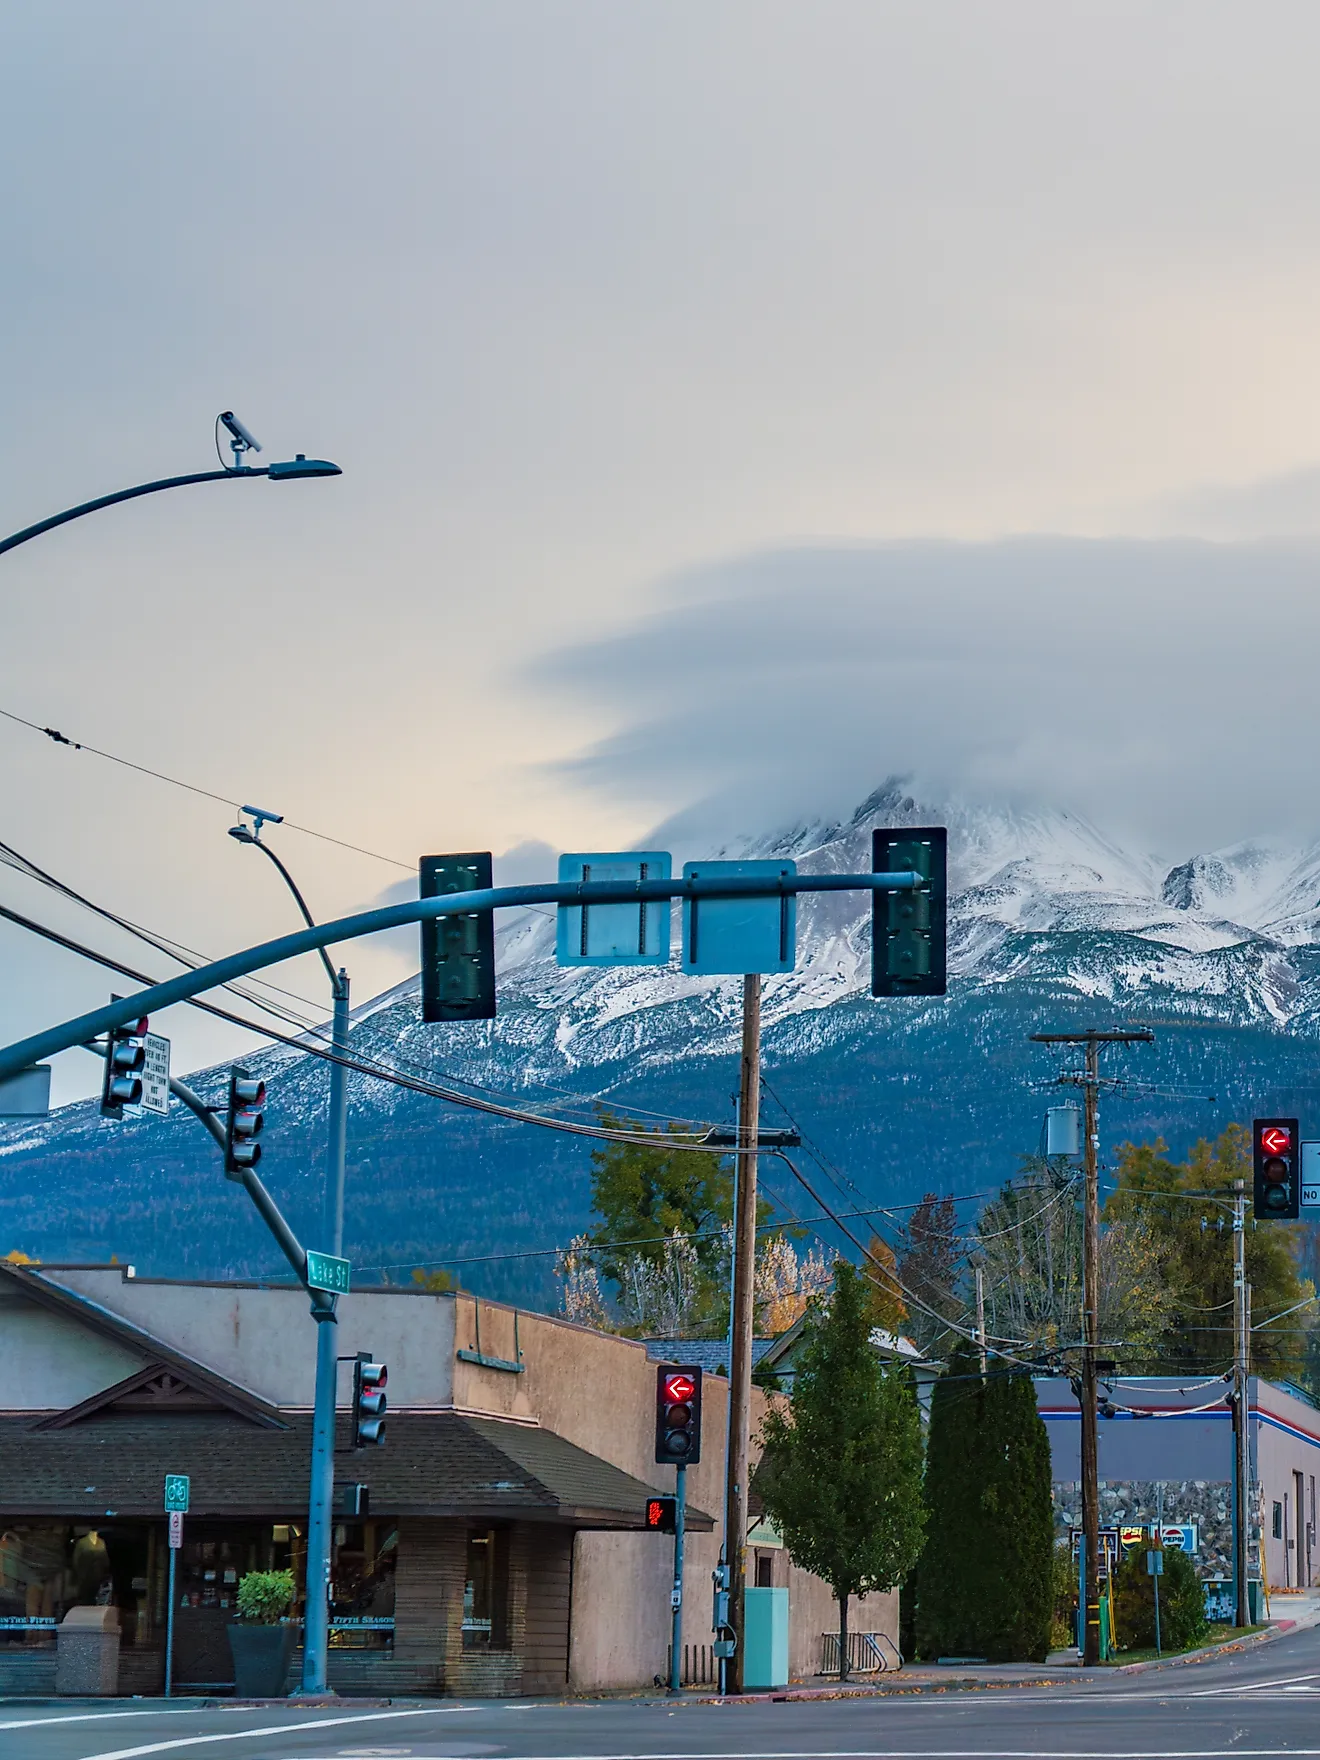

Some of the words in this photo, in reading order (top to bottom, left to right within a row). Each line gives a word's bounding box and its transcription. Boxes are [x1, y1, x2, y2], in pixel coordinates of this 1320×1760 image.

[1303, 1190, 1318, 1200] NO
[310, 1260, 333, 1285] Lake
[335, 1264, 346, 1288] St
